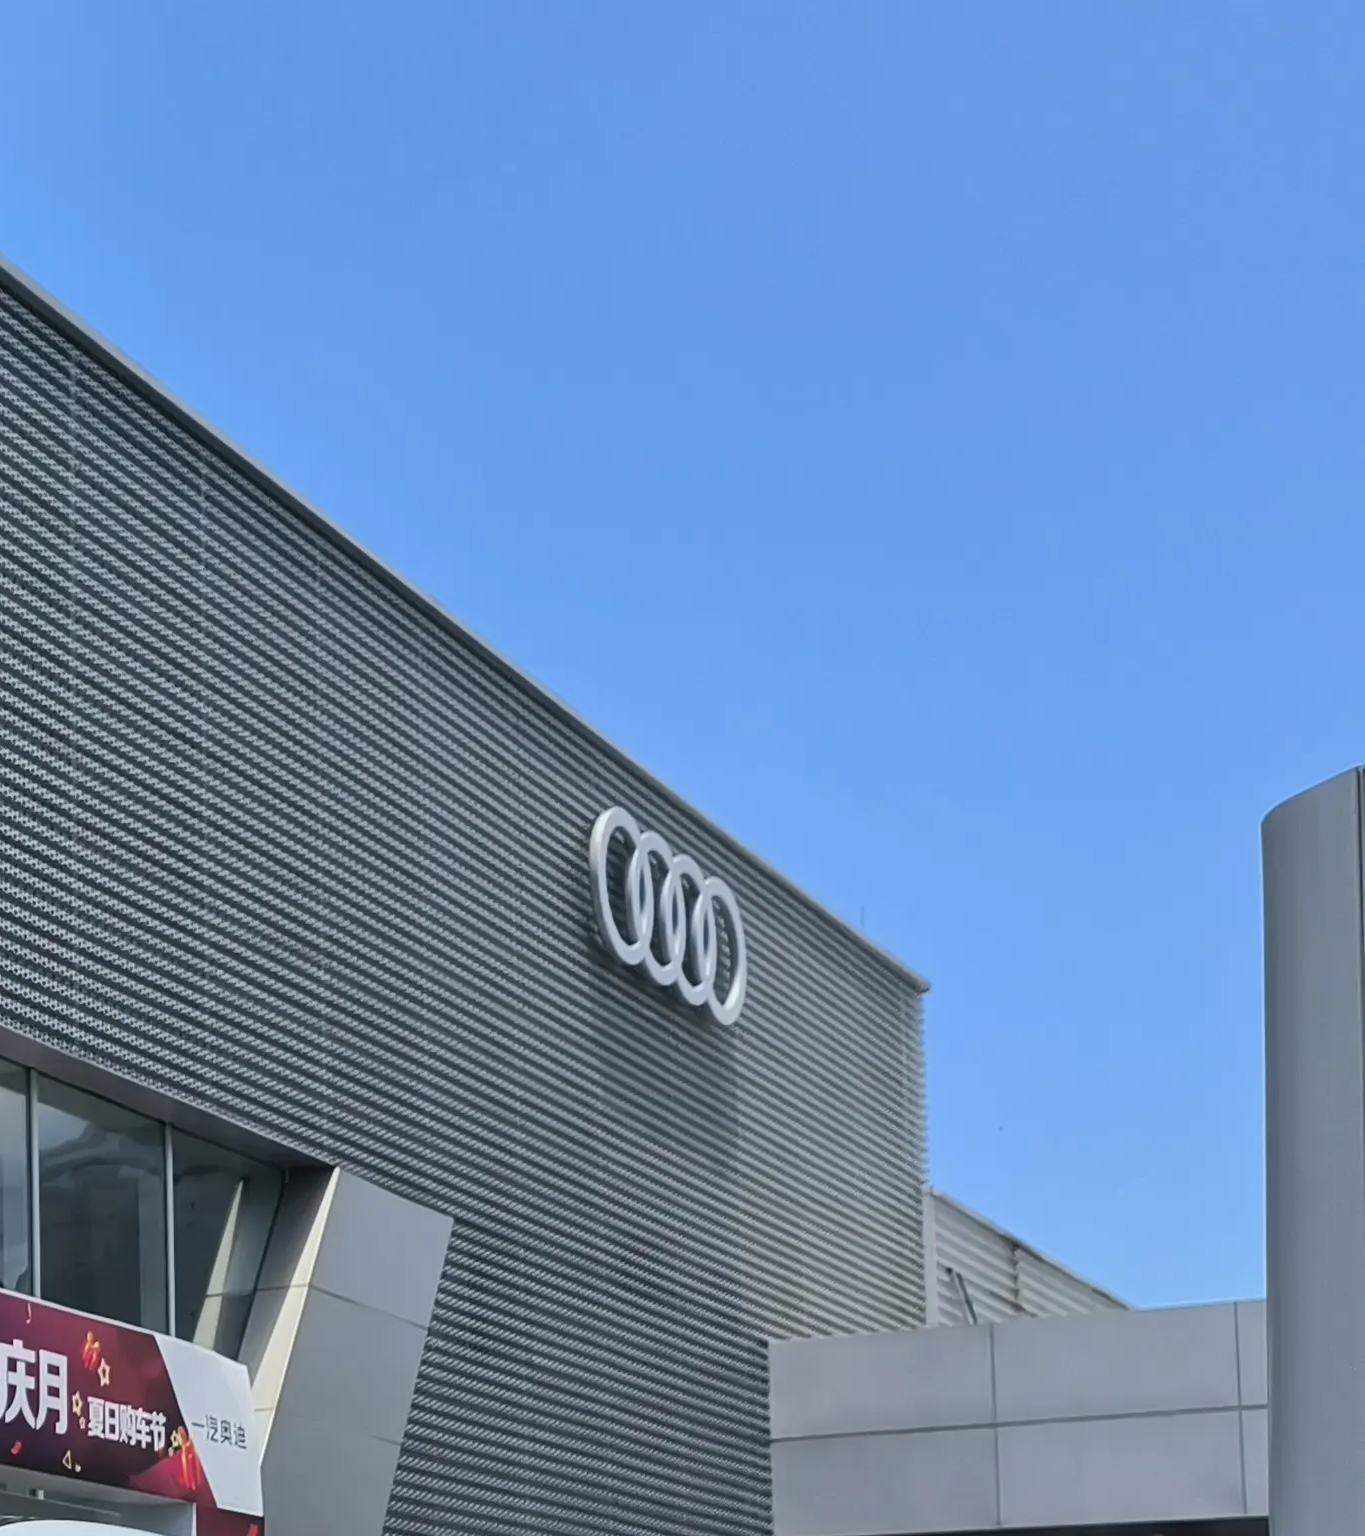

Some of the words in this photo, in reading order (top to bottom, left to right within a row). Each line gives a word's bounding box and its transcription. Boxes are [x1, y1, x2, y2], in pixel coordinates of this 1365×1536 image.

[87, 1396, 167, 1452] 夏日购车节
[191, 1414, 247, 1450] 一汽奥迪
